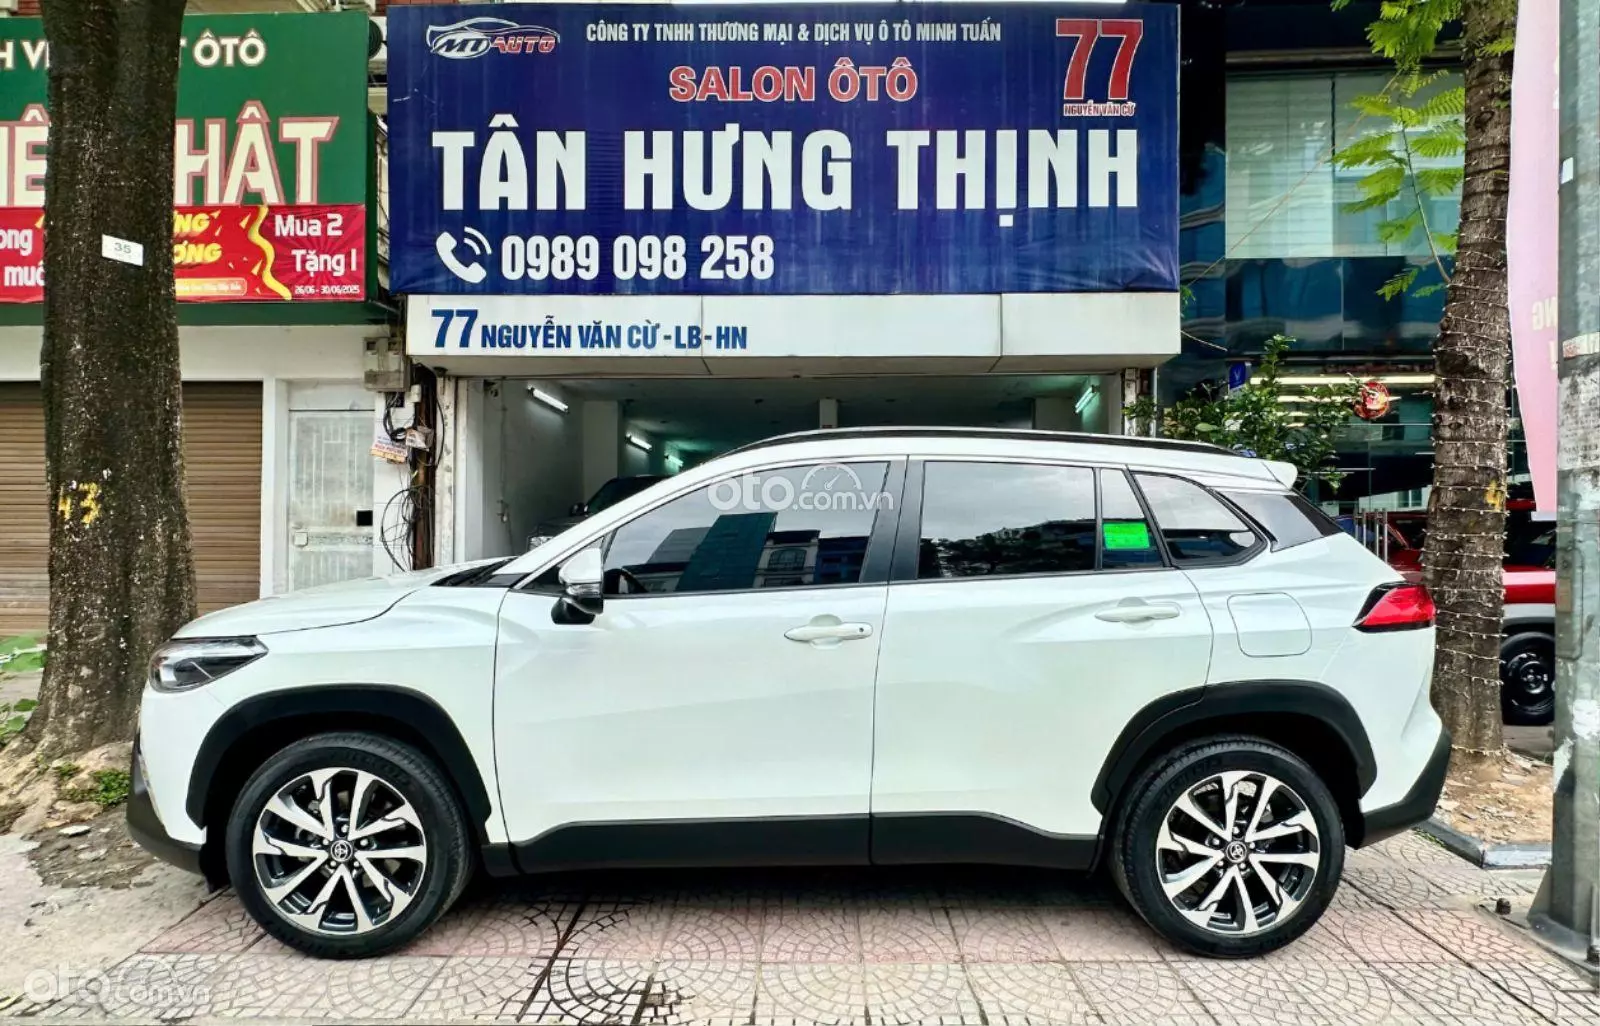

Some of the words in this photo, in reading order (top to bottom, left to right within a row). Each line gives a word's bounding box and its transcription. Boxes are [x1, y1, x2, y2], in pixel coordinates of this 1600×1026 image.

[193, 27, 266, 67] ÔTÔ
[490, 36, 556, 54] AUTO
[586, 19, 629, 42] CÔNG
[632, 23, 650, 42] TY
[654, 23, 694, 42] TNHH
[698, 21, 759, 42] THƯƠNG
[763, 23, 793, 46] MẠI
[797, 23, 810, 42] &
[814, 23, 850, 46] DỊCH
[854, 23, 874, 46] VỤ
[878, 19, 889, 42] Ô
[892, 19, 912, 42] TÔ
[916, 23, 957, 42] MINH
[960, 16, 1001, 42] TUẤN
[668, 65, 815, 103] SALON
[828, 56, 918, 103] ÔTÔ
[1055, 18, 1143, 101] 77
[432, 113, 586, 211] TÂN
[624, 122, 852, 211] HƯNG
[886, 128, 1138, 228] THỊNH
[274, 214, 322, 237] Mua
[327, 213, 344, 237] 2
[291, 248, 346, 277] Tặng
[501, 234, 600, 281] 0989
[612, 234, 687, 281] 098
[700, 234, 775, 281] 258
[431, 308, 479, 349] 77
[481, 314, 572, 349] NGUYỄN
[577, 319, 622, 350] VĂN
